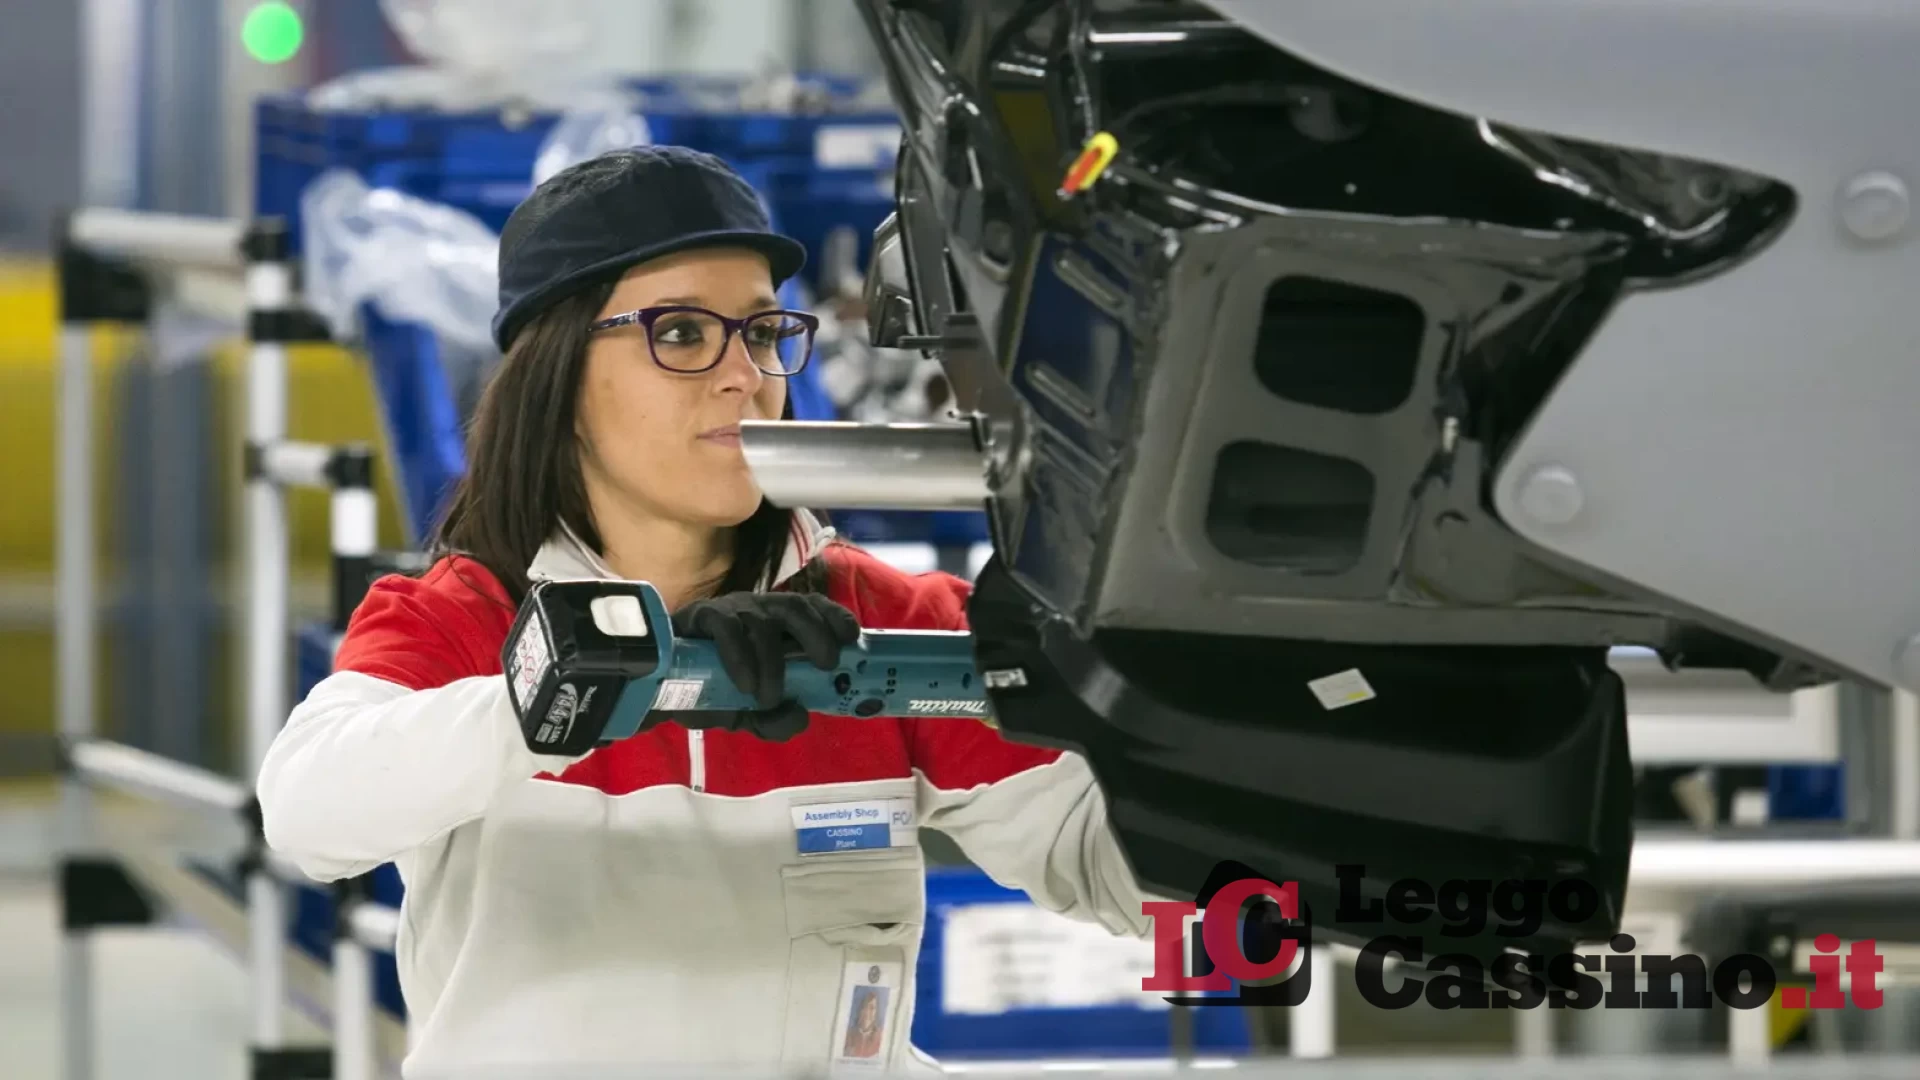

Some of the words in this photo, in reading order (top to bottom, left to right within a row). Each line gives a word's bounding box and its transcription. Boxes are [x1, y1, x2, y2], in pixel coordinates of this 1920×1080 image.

[804, 809, 852, 821] Assembly
[855, 808, 879, 819] Shop
[892, 810, 913, 826] FC
[826, 827, 863, 838] CASSINO
[836, 840, 857, 848] Plant
